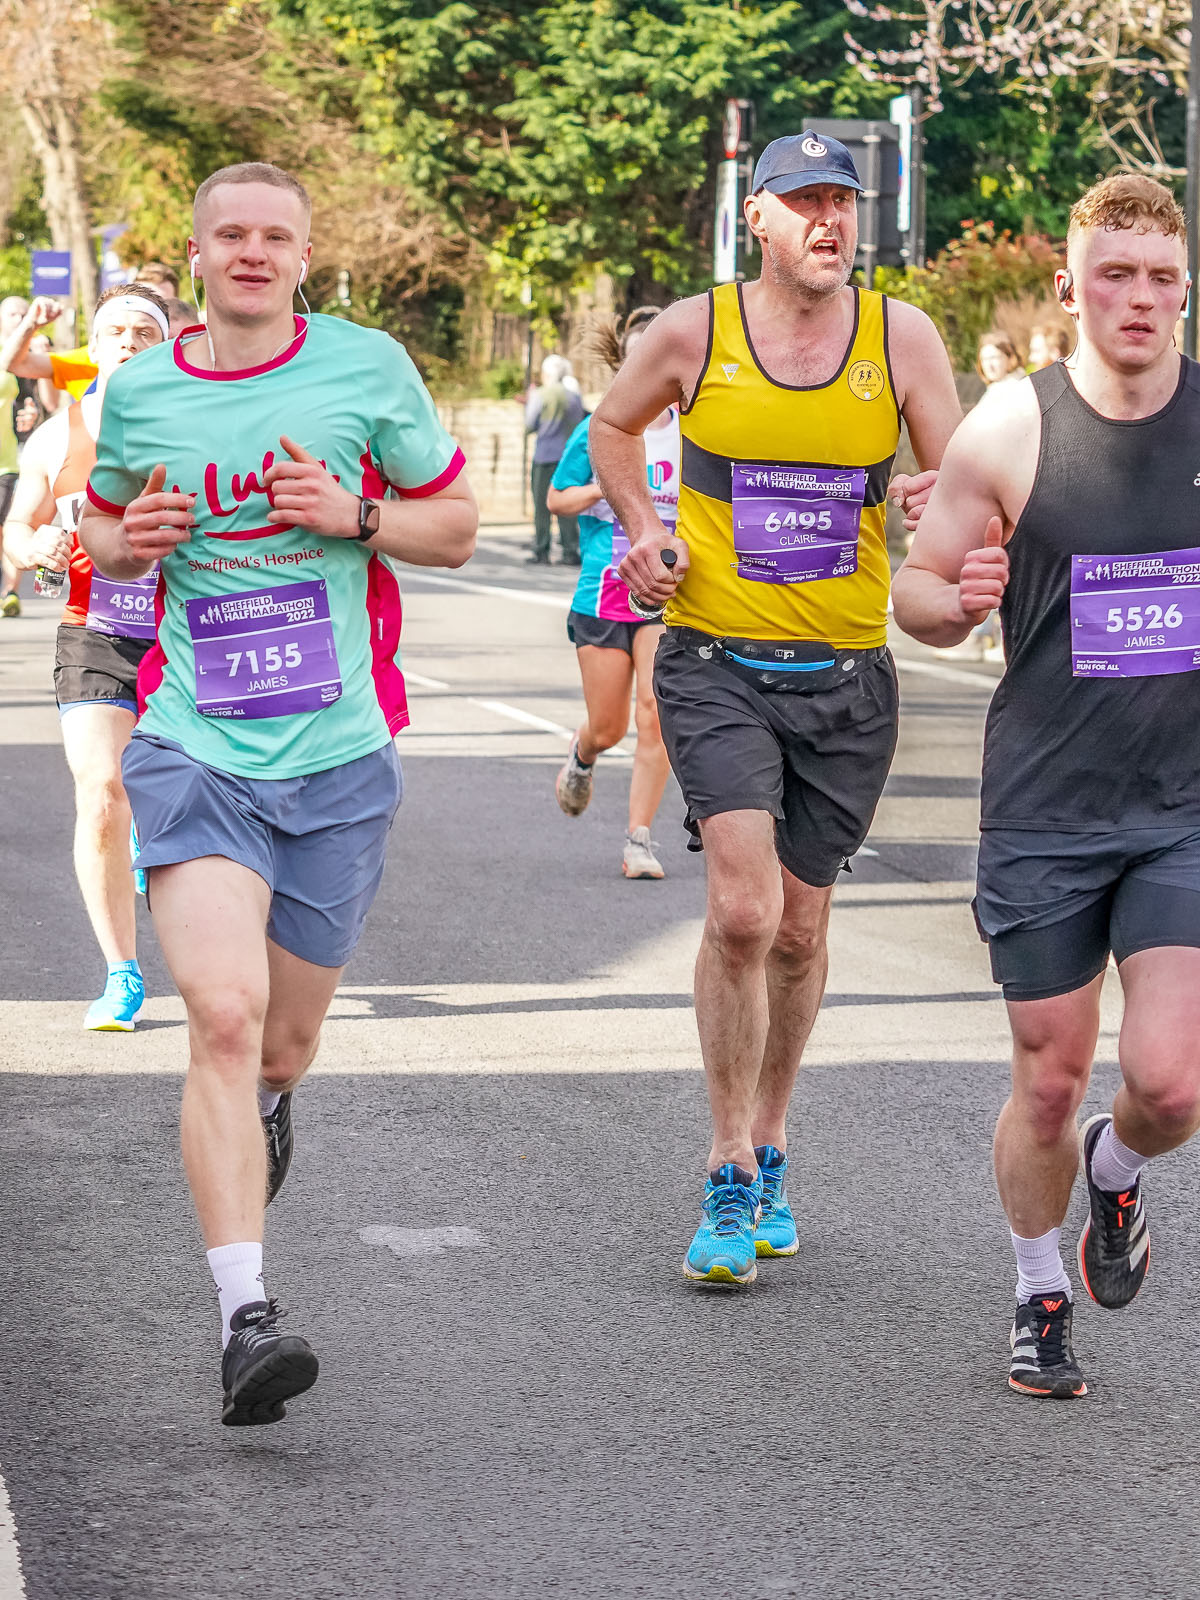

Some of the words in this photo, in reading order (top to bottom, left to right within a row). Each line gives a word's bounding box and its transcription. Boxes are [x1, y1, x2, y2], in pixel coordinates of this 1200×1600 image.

[772, 472, 815, 482] SHEFFIELD
[796, 483, 850, 491] MARATHON
[737, 520, 744, 529] L
[764, 511, 832, 533] 6495
[780, 534, 818, 546] CLAIRE
[188, 555, 261, 574] Sheffield's
[264, 547, 325, 568] Hospice
[1114, 560, 1161, 570] SHEFFIELD
[832, 564, 855, 576] 6495
[1112, 569, 1140, 579] HALF
[1141, 564, 1200, 576] MARATHON
[1172, 574, 1200, 584] 2022
[92, 592, 99, 600] M
[222, 596, 271, 612] SHEFFIELD
[224, 609, 251, 622] HALF
[252, 598, 313, 618] MARATHON
[121, 612, 146, 622] MARK
[286, 608, 316, 623] 2022
[1106, 604, 1183, 633] 5526
[1074, 618, 1082, 628] L
[1124, 634, 1166, 648] JAMES
[225, 642, 303, 678] 7155
[200, 664, 207, 676] L
[247, 675, 289, 692] JAMES
[233, 708, 246, 716] ALL
